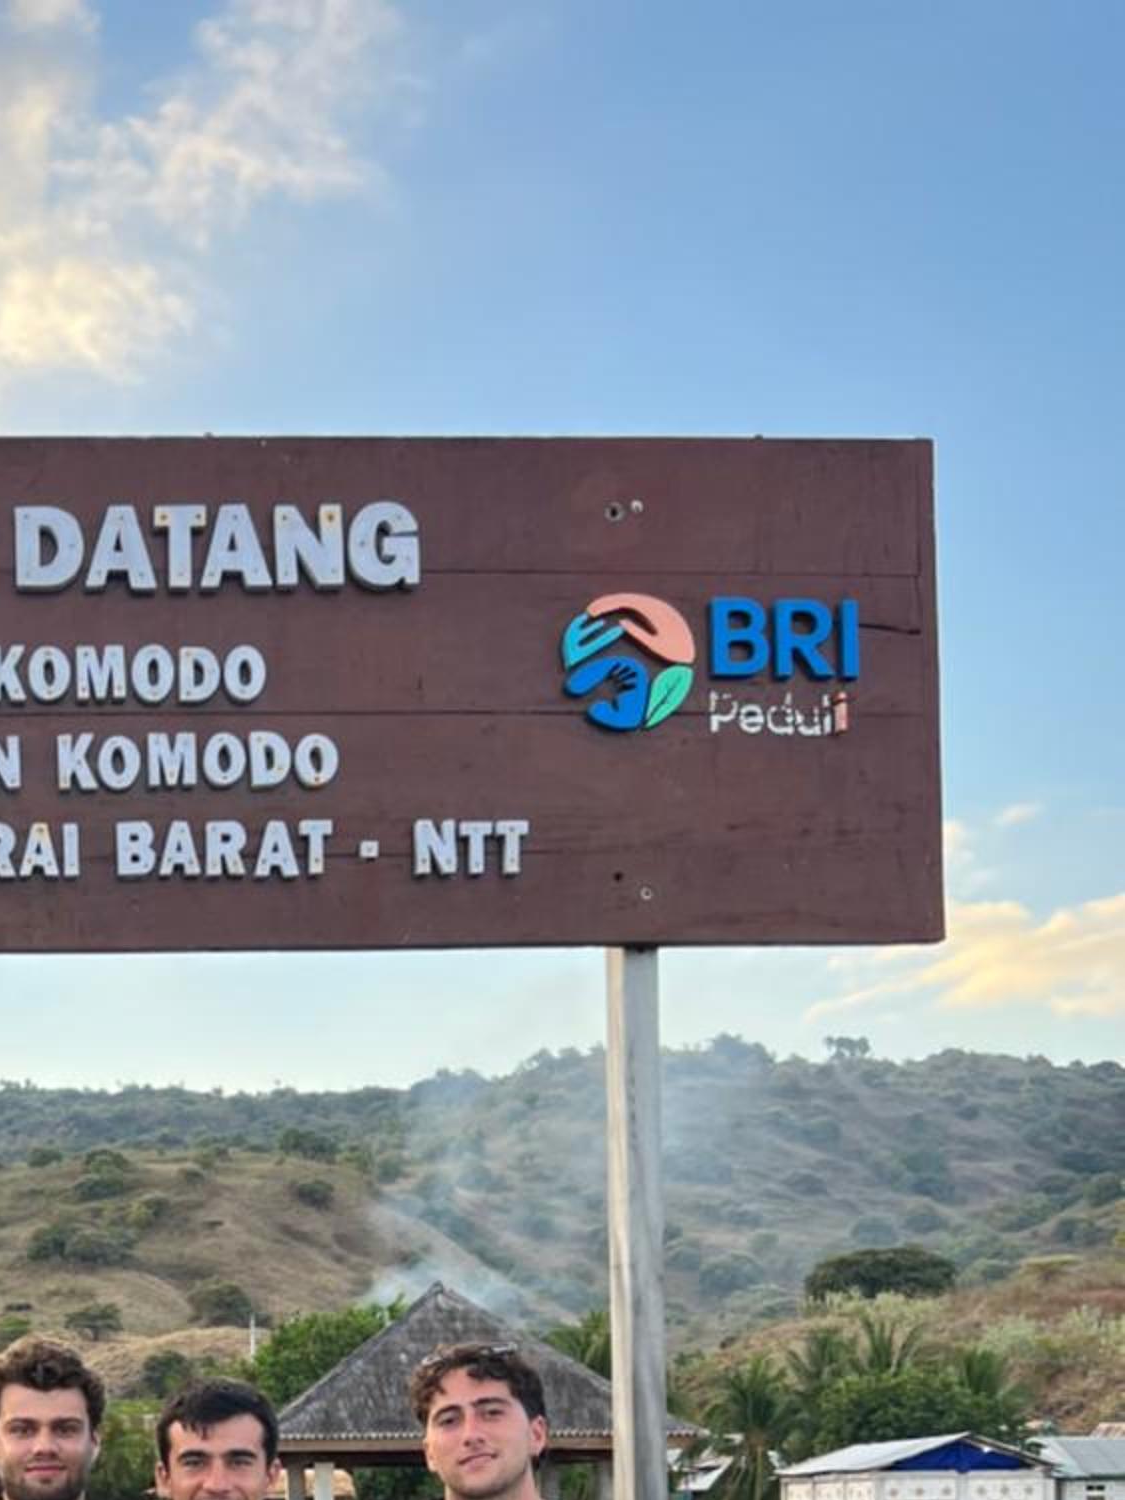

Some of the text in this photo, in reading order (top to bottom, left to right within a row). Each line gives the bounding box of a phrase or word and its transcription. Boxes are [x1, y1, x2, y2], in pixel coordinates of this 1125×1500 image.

[13, 501, 421, 591] DATANG
[708, 597, 860, 681] BRI
[57, 730, 340, 791] KOMODO
[116, 819, 334, 879] BARAT
[414, 819, 529, 876] NTT
